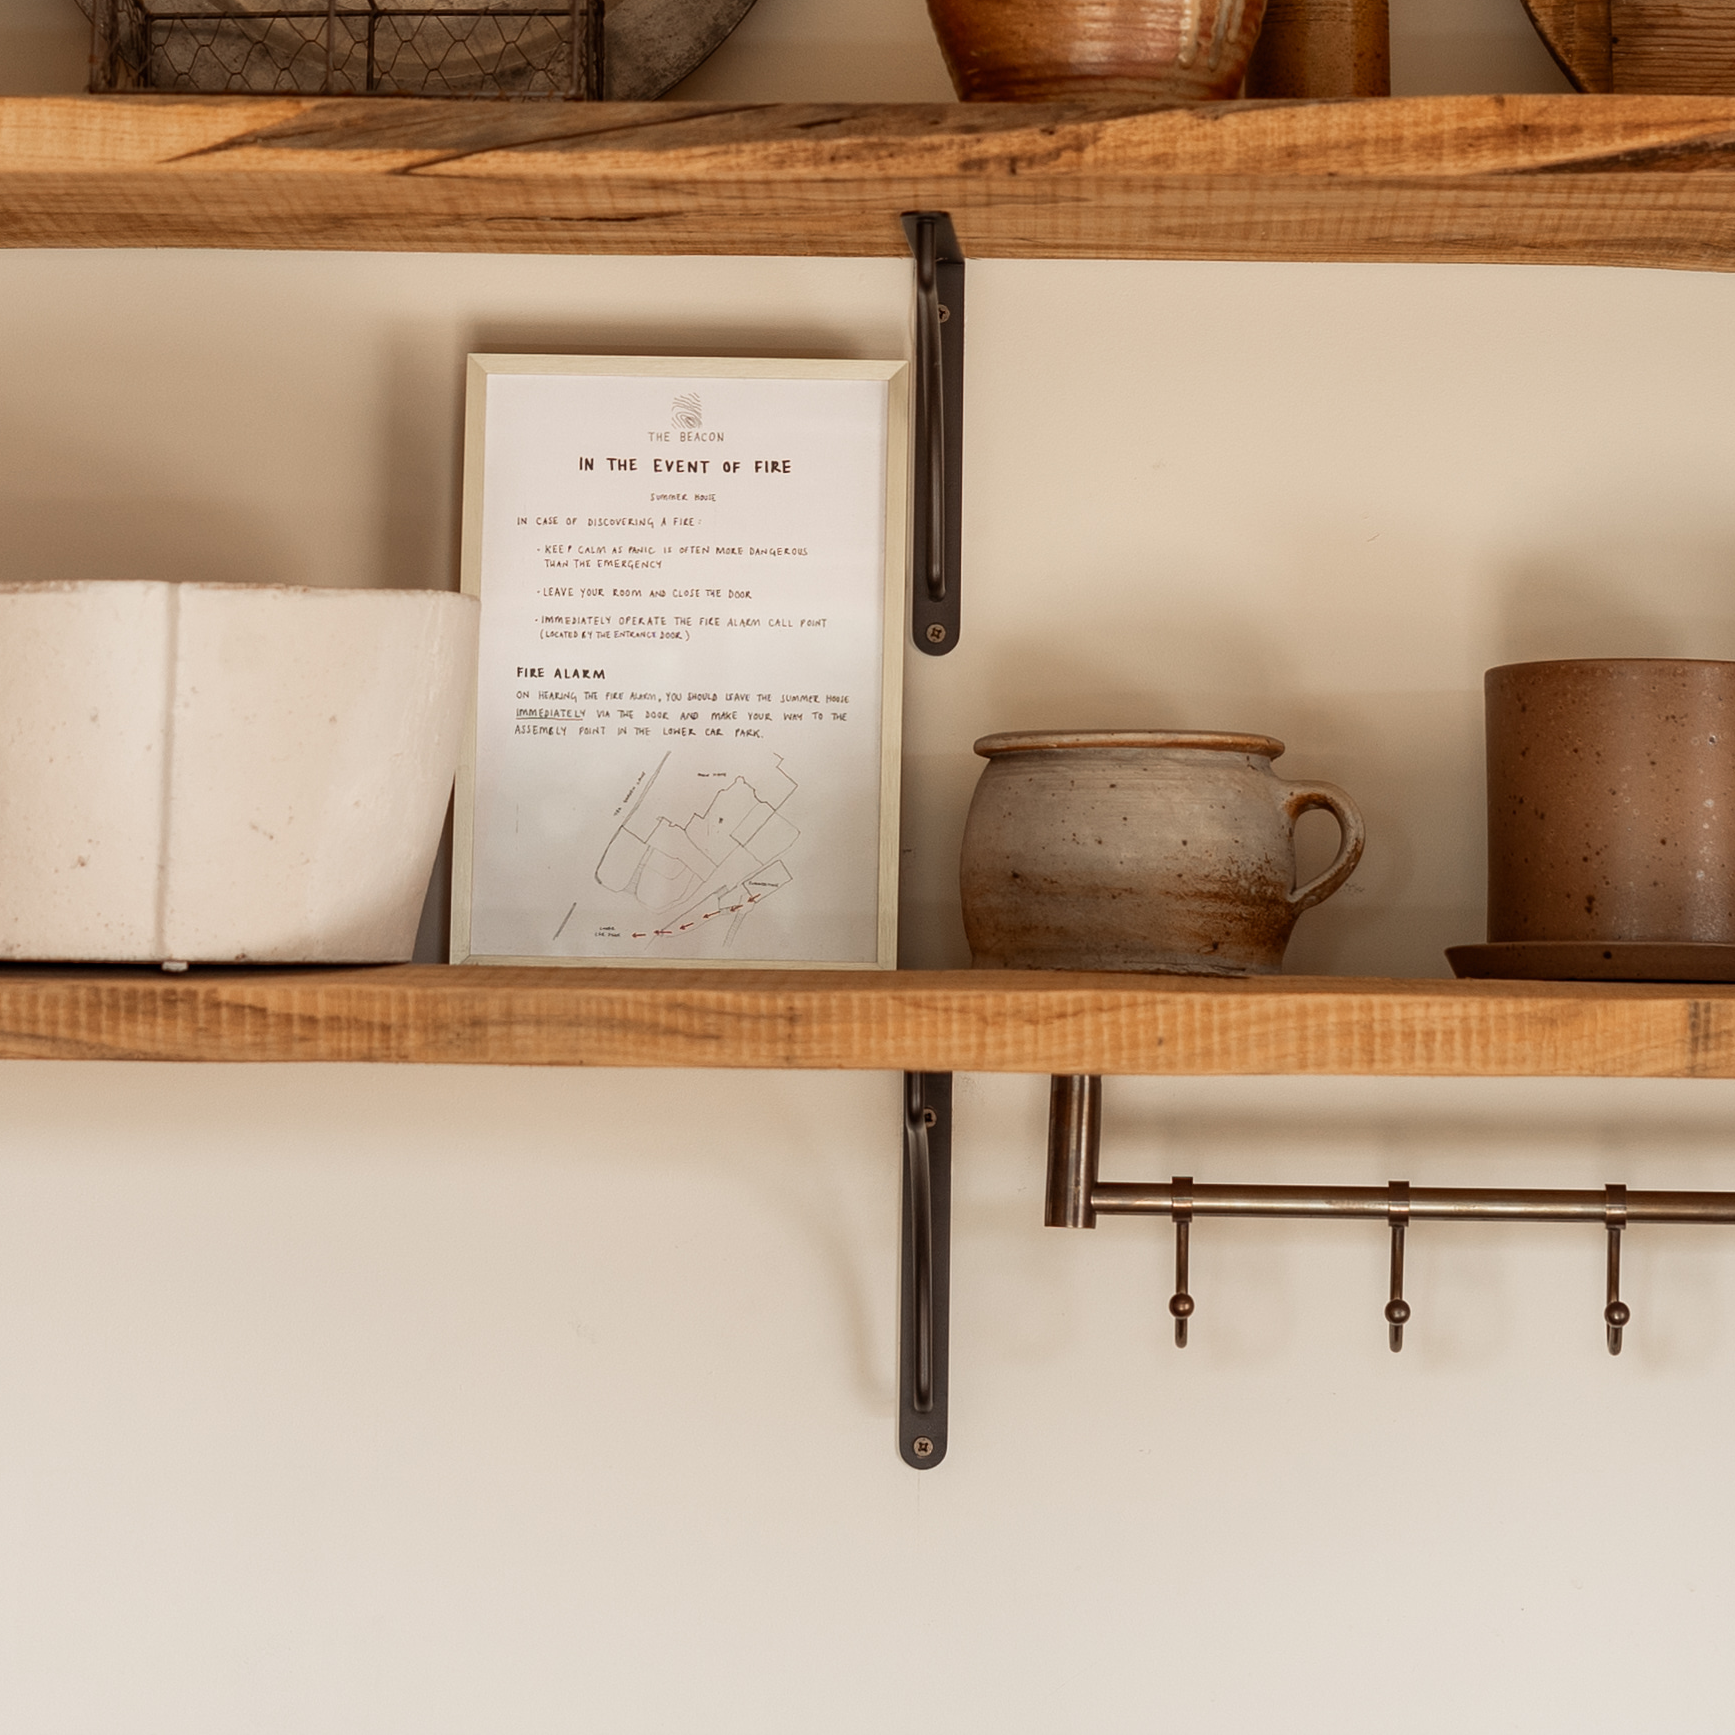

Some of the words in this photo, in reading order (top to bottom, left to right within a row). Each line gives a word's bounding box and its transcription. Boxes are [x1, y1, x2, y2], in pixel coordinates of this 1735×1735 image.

[648, 432, 670, 442] THE
[680, 431, 724, 442] BEACON
[580, 457, 593, 471] IN
[607, 458, 637, 471] THE
[654, 459, 709, 473] EVENT
[723, 462, 740, 473] OF
[755, 460, 791, 473] FIRE
[651, 493, 688, 501] SUMMER
[695, 494, 716, 502] HOUSE
[517, 517, 527, 525] IN
[536, 516, 558, 525] CASE
[588, 518, 654, 528] DISCOVERING
[661, 518, 666, 526] A
[545, 545, 572, 554] KEEP
[578, 546, 606, 554] CALM
[612, 546, 622, 554] AS
[629, 546, 655, 554] PANIC
[679, 546, 709, 554] OFTEN
[716, 547, 742, 555] MORE
[750, 547, 807, 556] DANGEROUS
[545, 559, 568, 567] THAN
[574, 559, 590, 568] THE
[597, 559, 661, 570] EMERGENCY
[544, 587, 573, 596] LEAVE
[580, 588, 604, 598] YOUR
[673, 589, 699, 597] CLOSE
[706, 589, 721, 597] THE
[729, 590, 752, 599] DOOR
[542, 616, 611, 625] IMMEDIATELY
[619, 616, 666, 625] OPERATE
[674, 617, 692, 626] THE
[699, 617, 719, 626] FIRE
[727, 618, 760, 627] ALARM
[768, 619, 793, 627] CALL
[800, 619, 826, 627] POINT
[540, 629, 578, 639] (LOCATED
[517, 667, 544, 678] FIRE
[554, 668, 605, 679] ALARM
[516, 691, 529, 699] ON
[539, 691, 577, 702] HEARING
[584, 691, 597, 700] THE
[606, 692, 623, 700] FIRE
[666, 692, 682, 702] YOU
[688, 693, 717, 701] SHOULD
[726, 693, 749, 701] LEAVE
[757, 694, 771, 702] THE
[781, 695, 820, 703] SUMMER
[517, 708, 585, 718] IMMEDIATELY
[597, 710, 610, 718] VIA
[617, 710, 633, 719] THE
[646, 711, 669, 720] DOOR
[680, 712, 698, 720] AND
[711, 711, 736, 720] MAKE
[748, 713, 772, 721] YOUR
[812, 712, 823, 720] TO
[831, 713, 847, 721] THE
[515, 725, 566, 736] ASSEMBLY
[579, 726, 605, 735] POINT
[618, 727, 627, 735] IN
[634, 727, 650, 736] THE
[663, 727, 696, 736] LOWER
